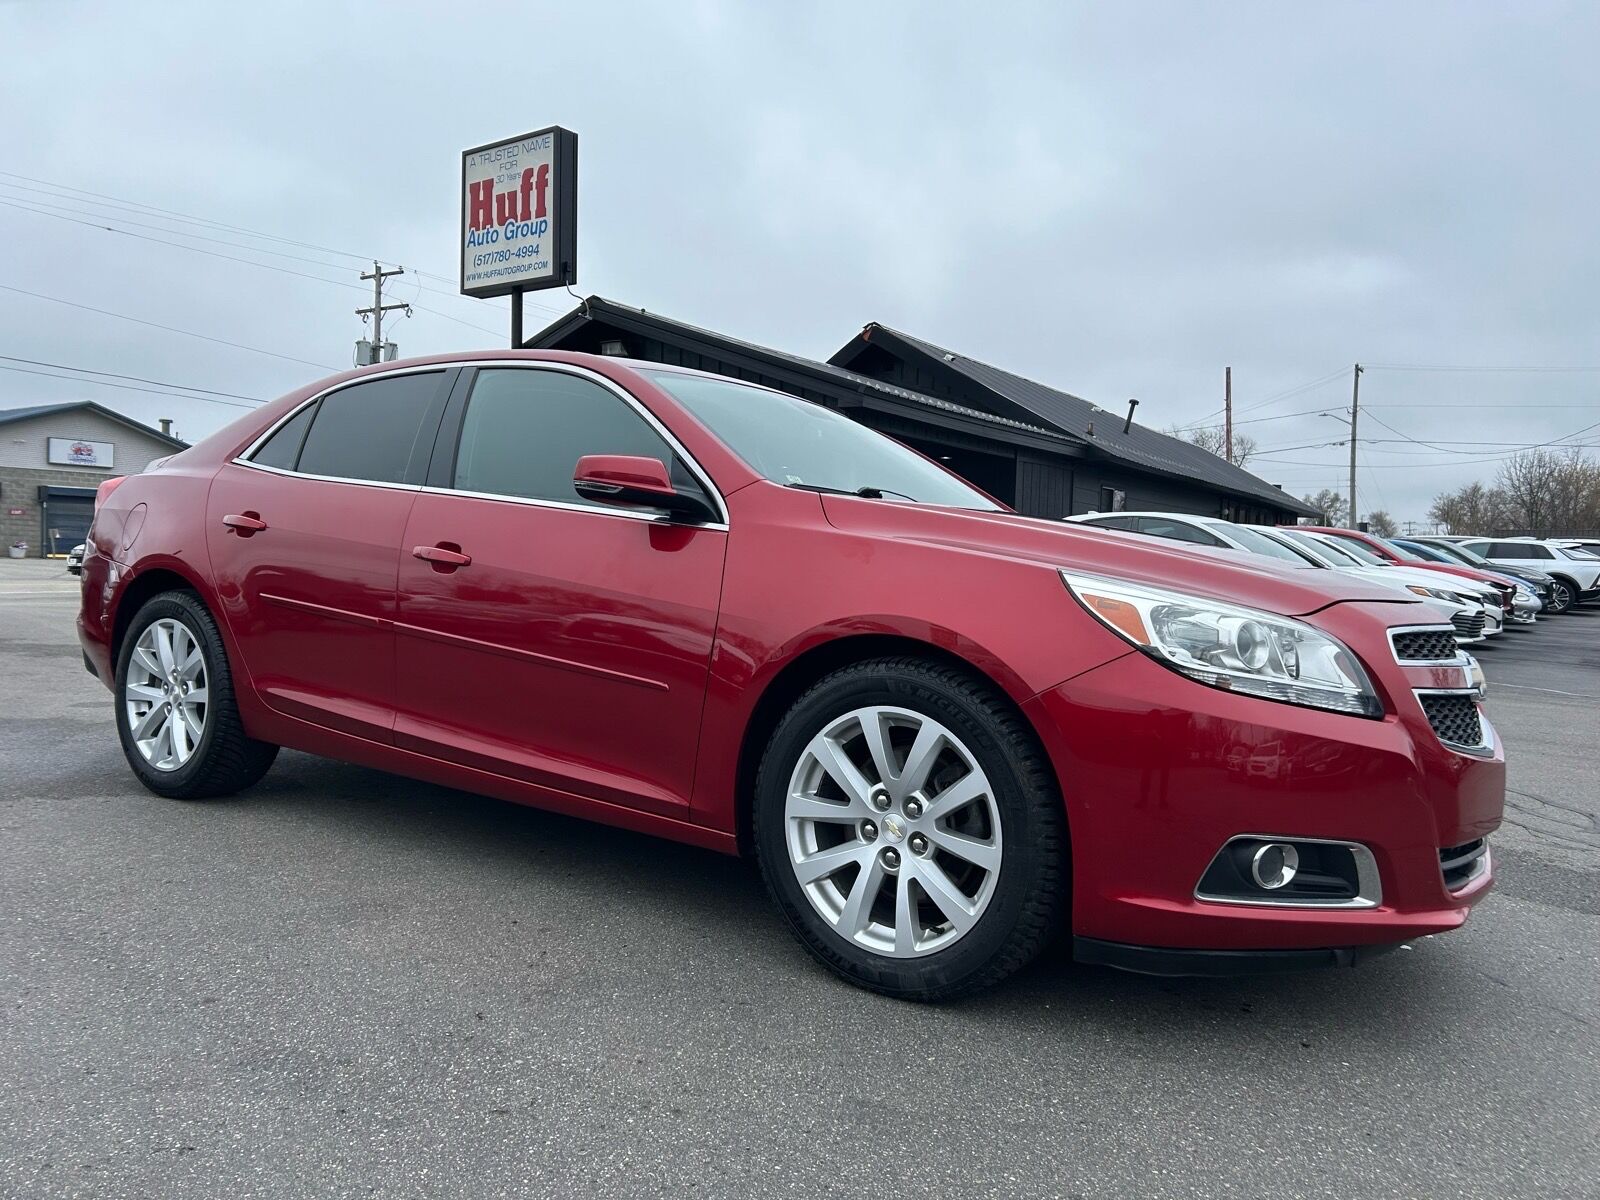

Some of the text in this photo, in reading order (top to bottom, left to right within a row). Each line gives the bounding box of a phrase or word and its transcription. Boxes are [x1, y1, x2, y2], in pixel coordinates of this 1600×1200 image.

[469, 136, 551, 169] A TRUSTED NAME
[495, 172, 522, 184] 30 Years
[499, 160, 518, 171] FOR
[468, 163, 549, 232] Huff
[466, 218, 548, 249] Auto Group
[473, 243, 540, 268] (517)780-4994
[466, 261, 548, 281] WWW.HUFFAUTOGROUP.COM
